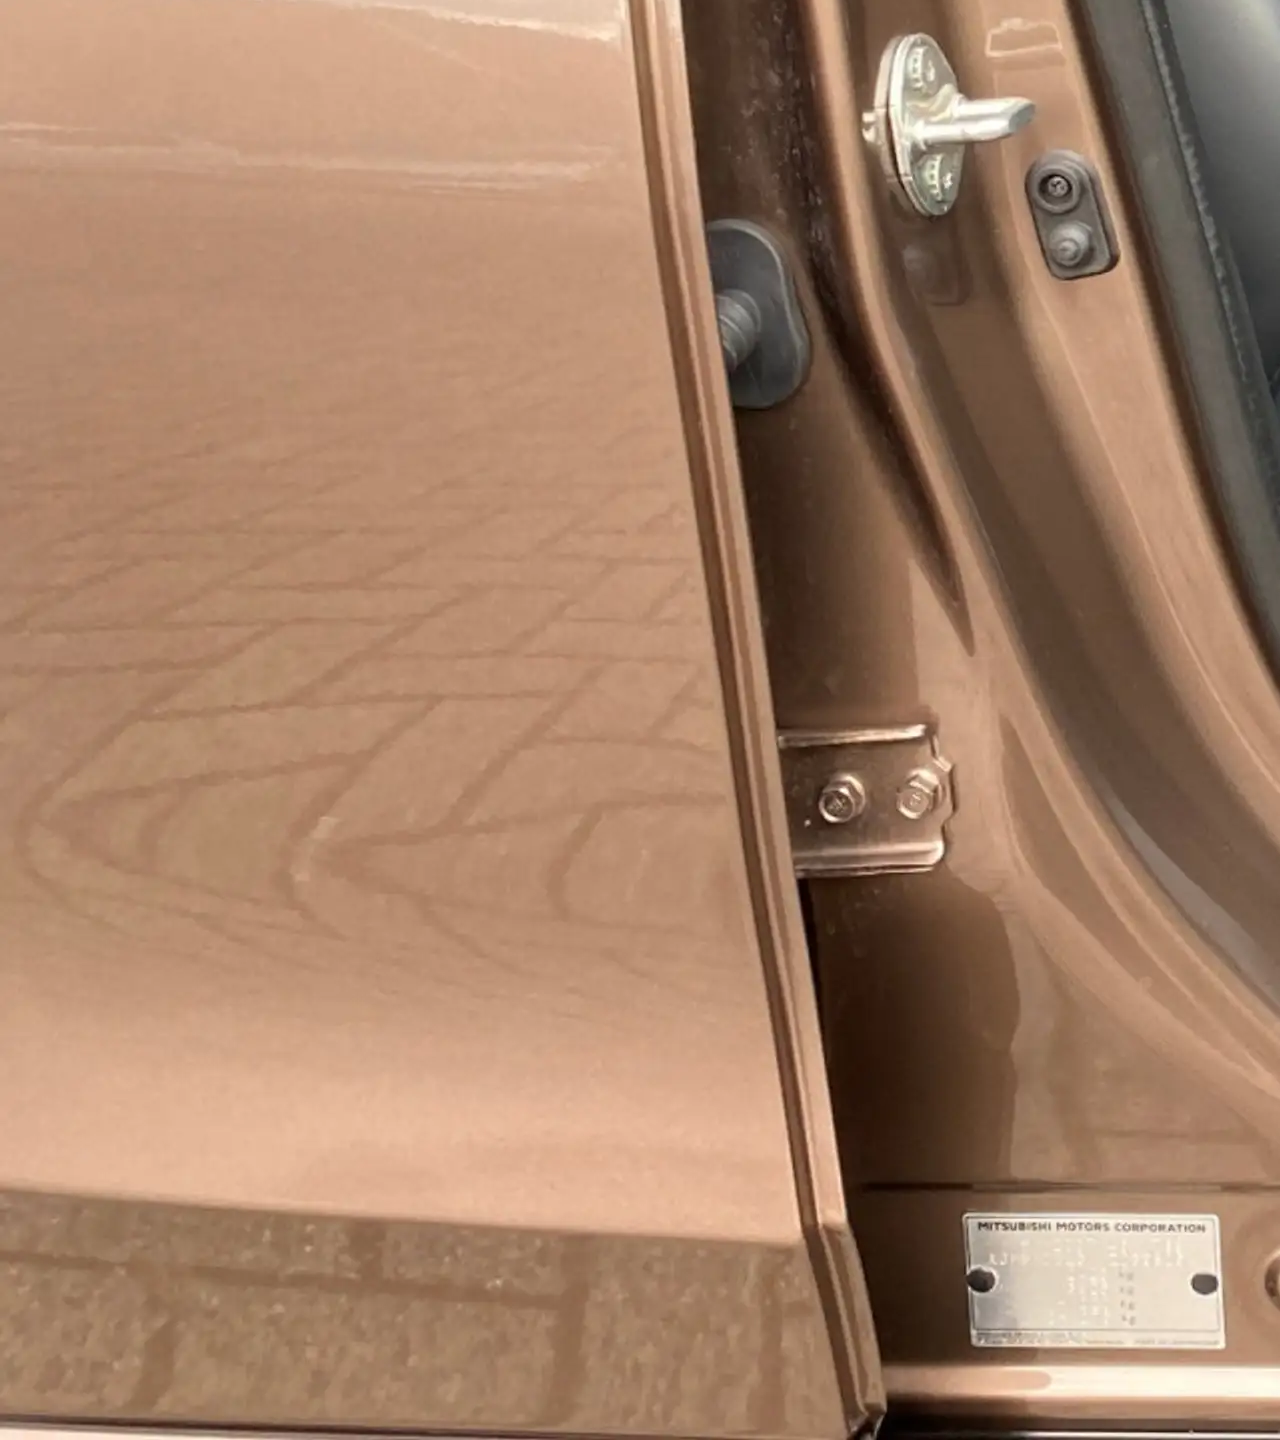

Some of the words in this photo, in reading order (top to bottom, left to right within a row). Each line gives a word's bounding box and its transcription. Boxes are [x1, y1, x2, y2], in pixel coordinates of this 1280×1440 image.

[977, 1221, 1052, 1232] MITSUBISHI
[1056, 1222, 1111, 1233] MOTORS
[1114, 1222, 1207, 1234] CORPORATION
